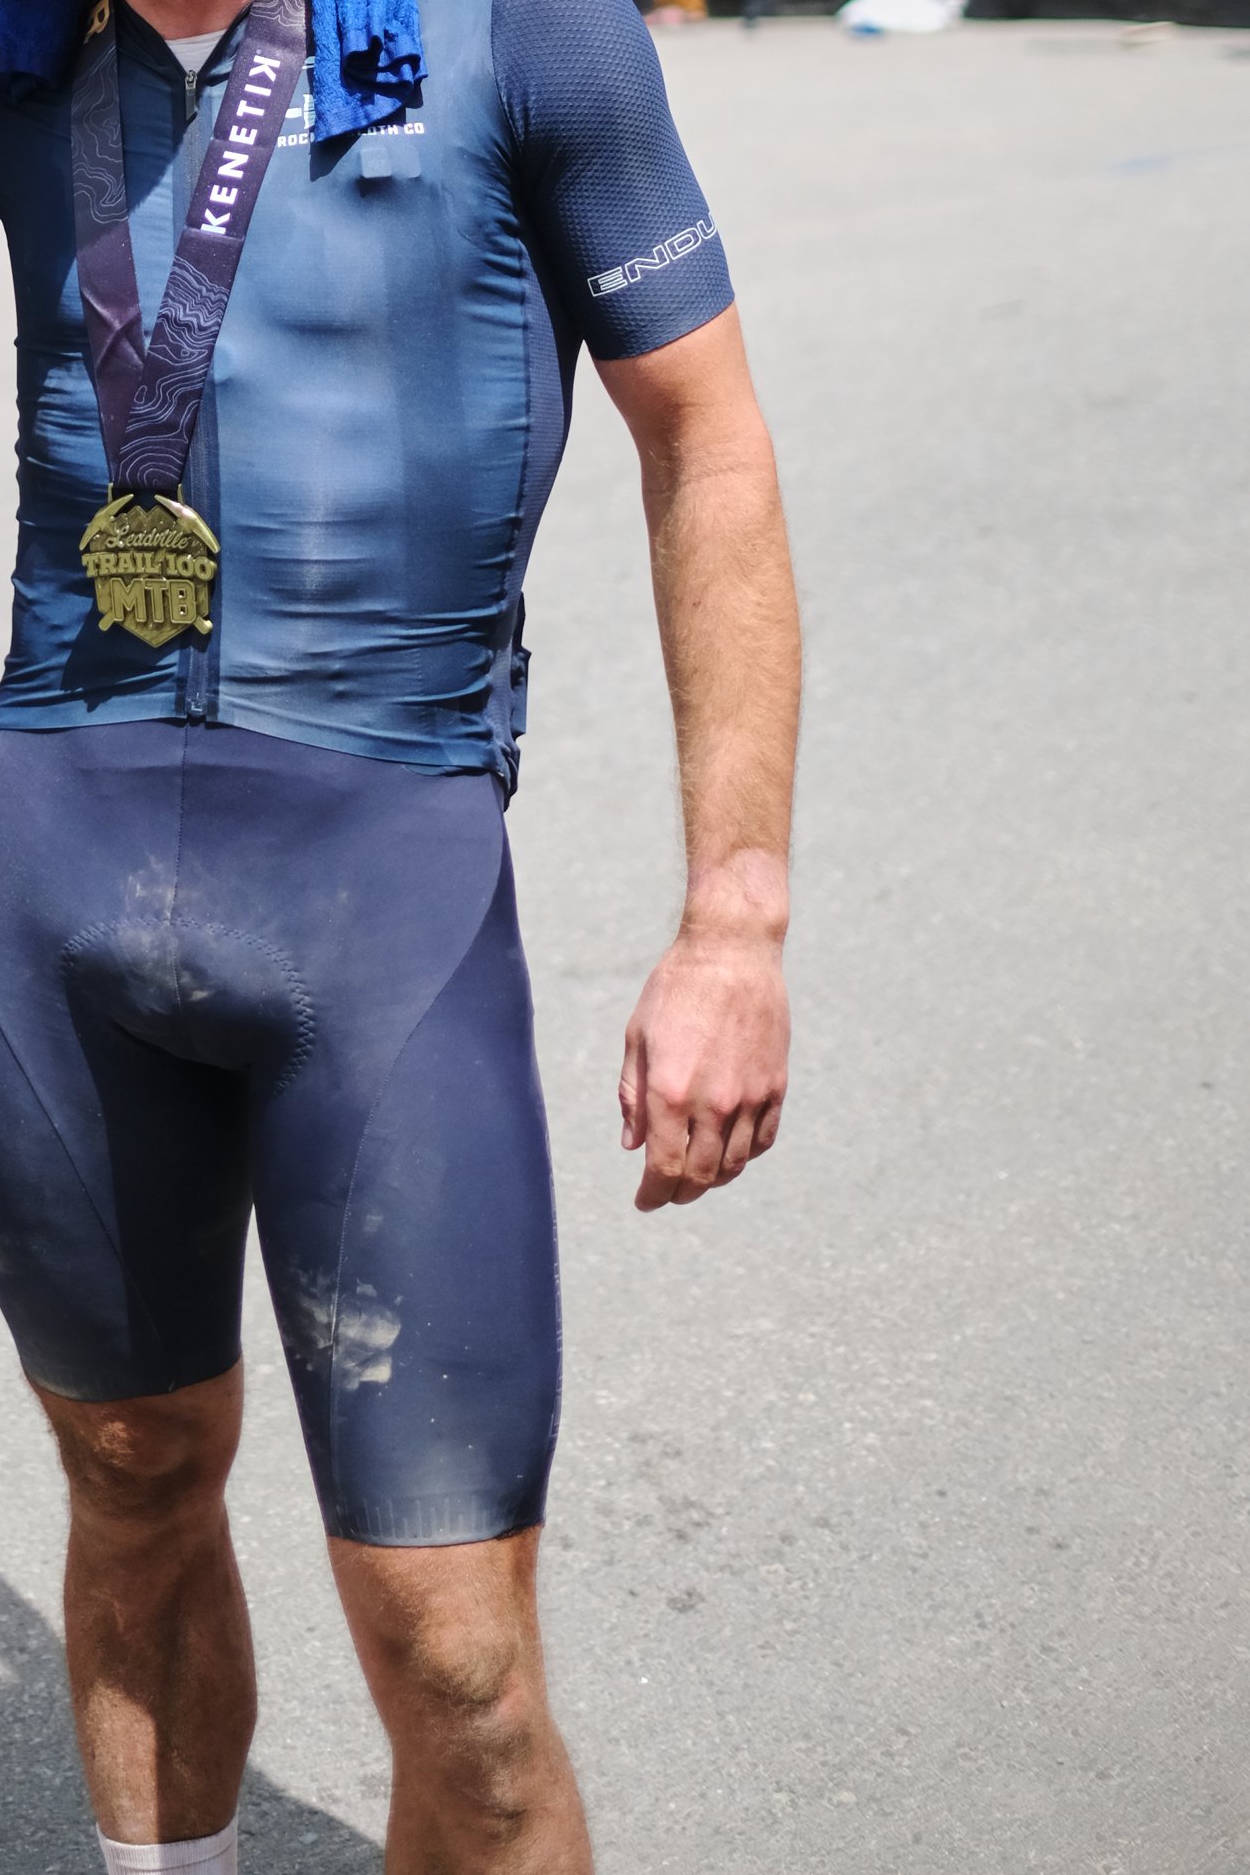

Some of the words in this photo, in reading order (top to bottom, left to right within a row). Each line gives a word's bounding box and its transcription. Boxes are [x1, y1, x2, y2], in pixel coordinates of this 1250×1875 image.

[404, 122, 425, 135] CO
[200, 54, 281, 235] KENETIK
[105, 525, 189, 549] Leadville
[81, 551, 161, 578] TRAIL
[165, 554, 217, 581] 100
[110, 577, 197, 623] MTB
